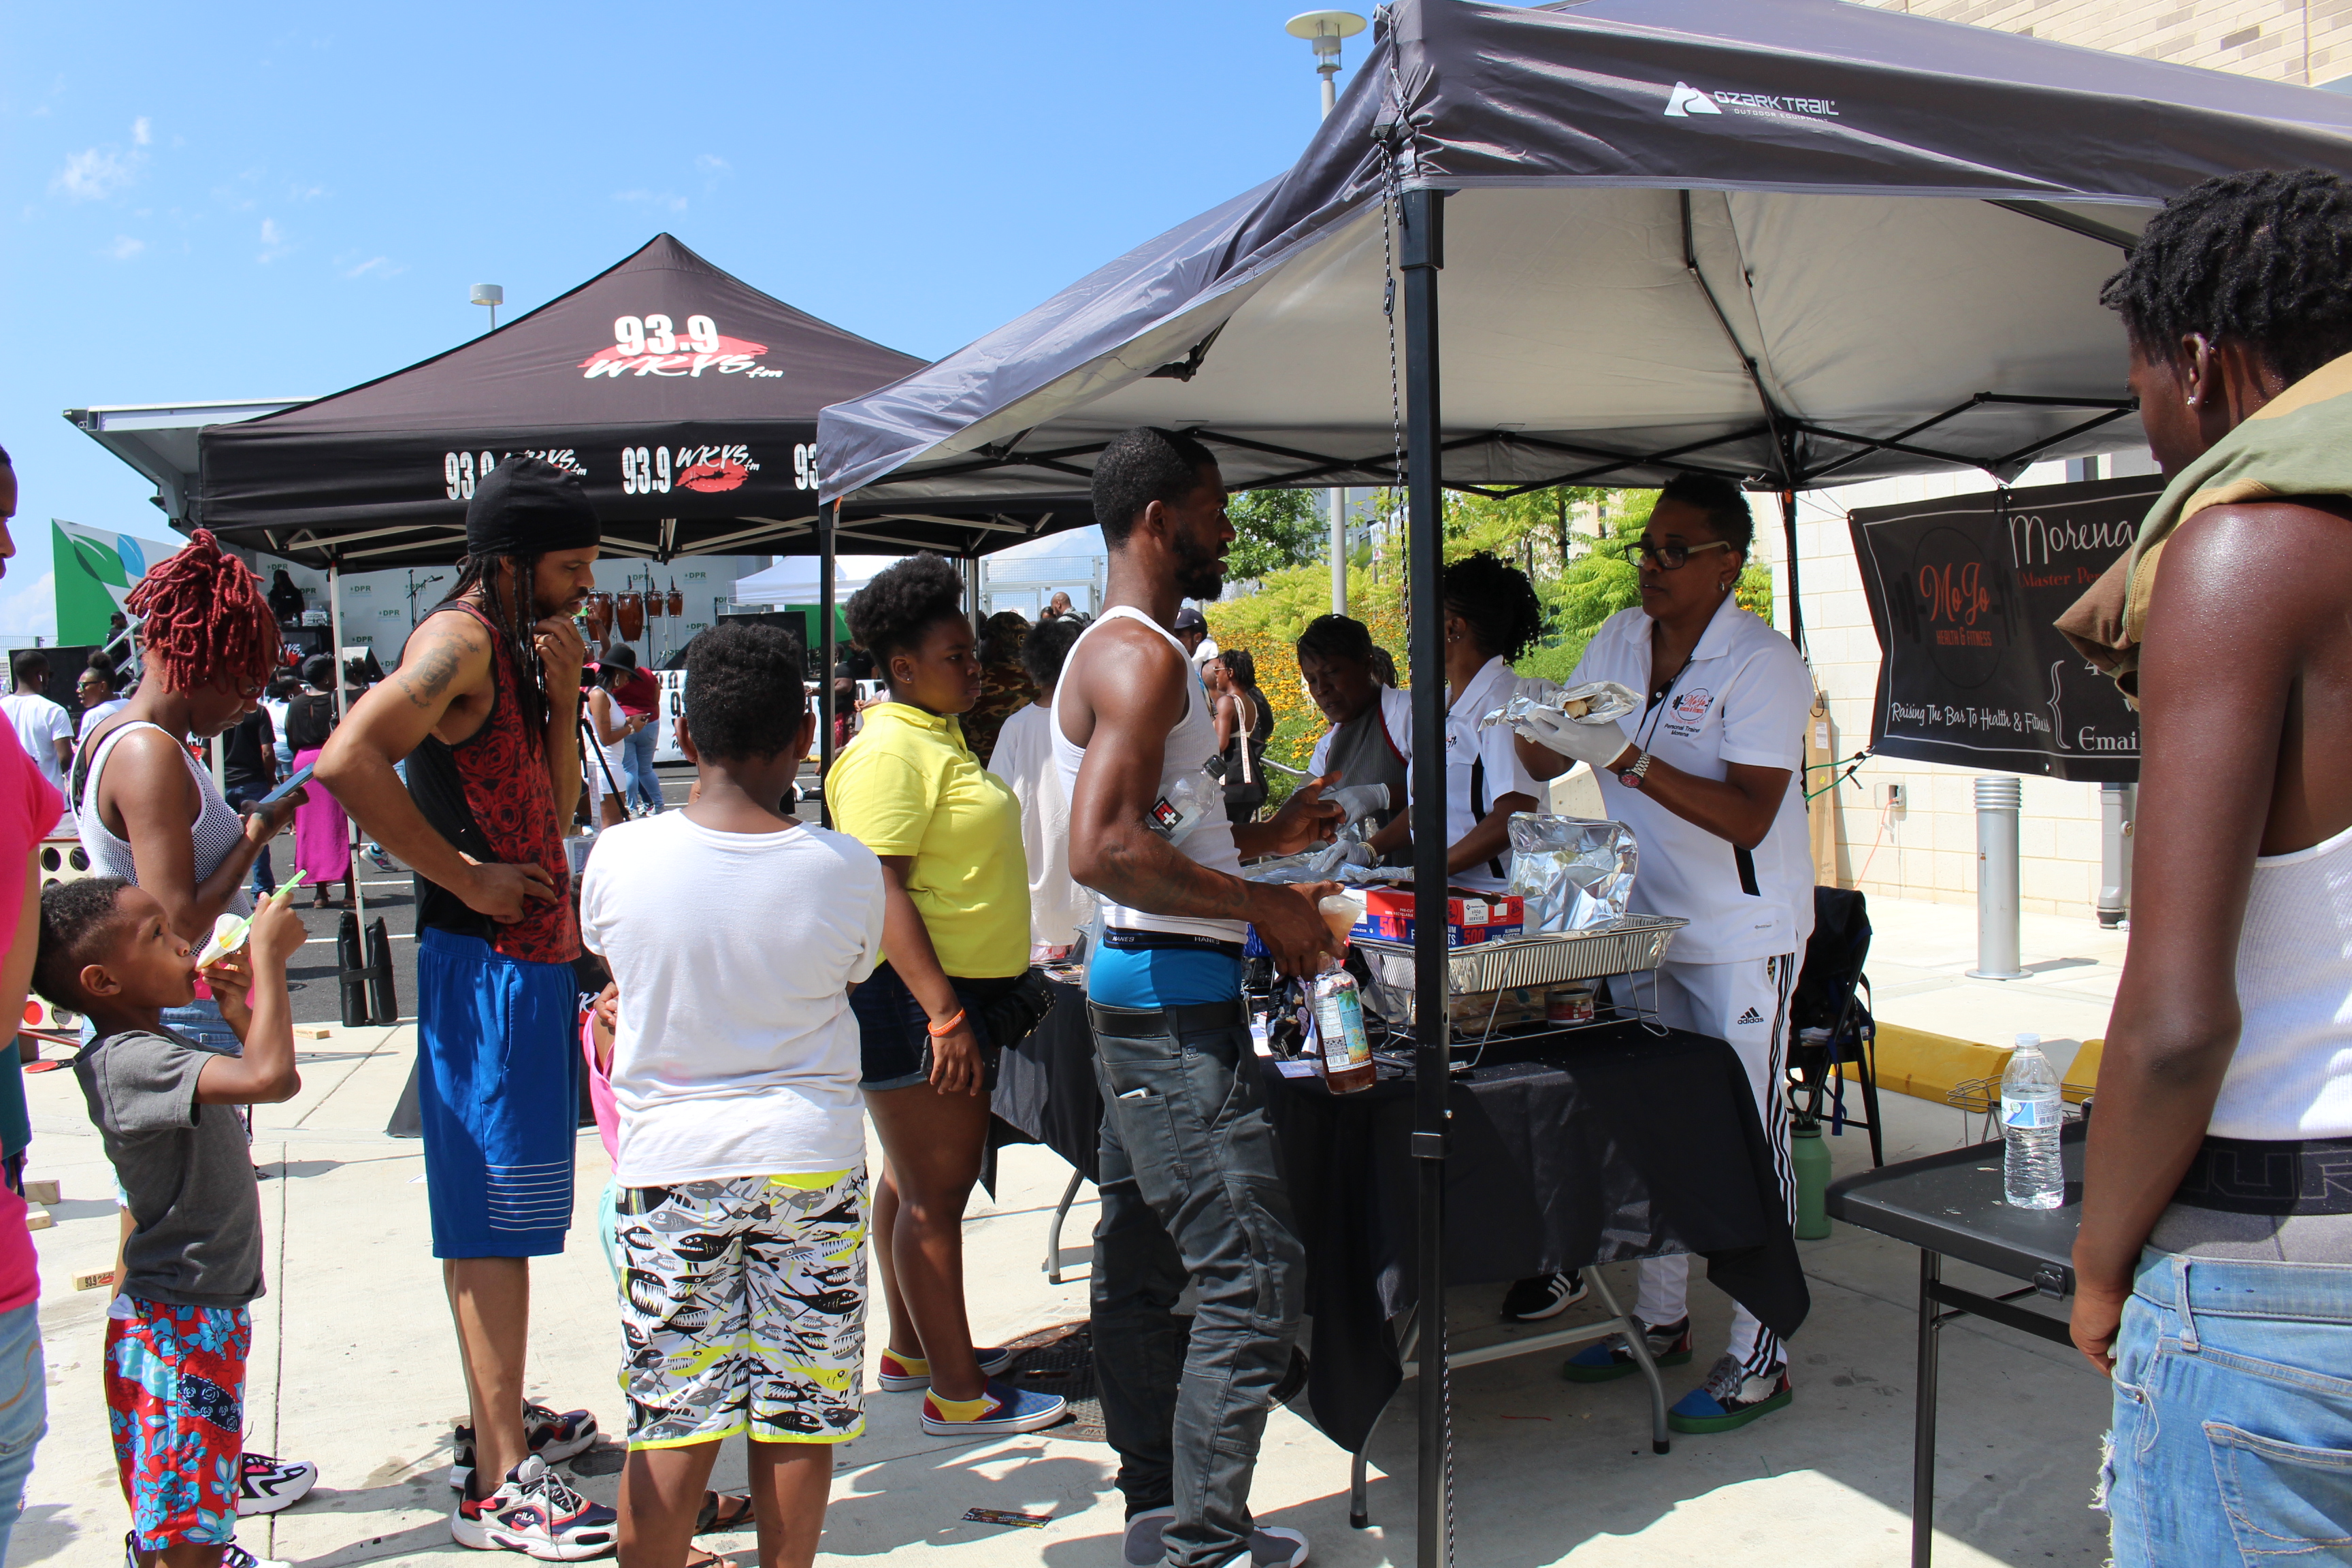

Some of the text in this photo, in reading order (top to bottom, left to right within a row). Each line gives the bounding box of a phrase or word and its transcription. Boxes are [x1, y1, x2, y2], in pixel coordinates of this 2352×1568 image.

[1734, 108, 1829, 124] OUTDOOR EQUIPMENT
[614, 314, 720, 356] 93.9
[622, 446, 671, 495] 93.9
[2008, 514, 2136, 568] Morena
[1920, 561, 1991, 625] MoJo
[1936, 626, 1993, 647] HEALTH & FITNESS
[1891, 702, 2051, 734] Raising The Bar To Health & Fitness
[2078, 725, 2140, 751] Emai
[1379, 917, 1407, 938] 500
[1463, 928, 1486, 945] 500
[1194, 936, 1220, 945] HANES
[1737, 1017, 1764, 1025] adidas
[85, 1275, 97, 1288] 93.9
[514, 1512, 536, 1522] FILA
